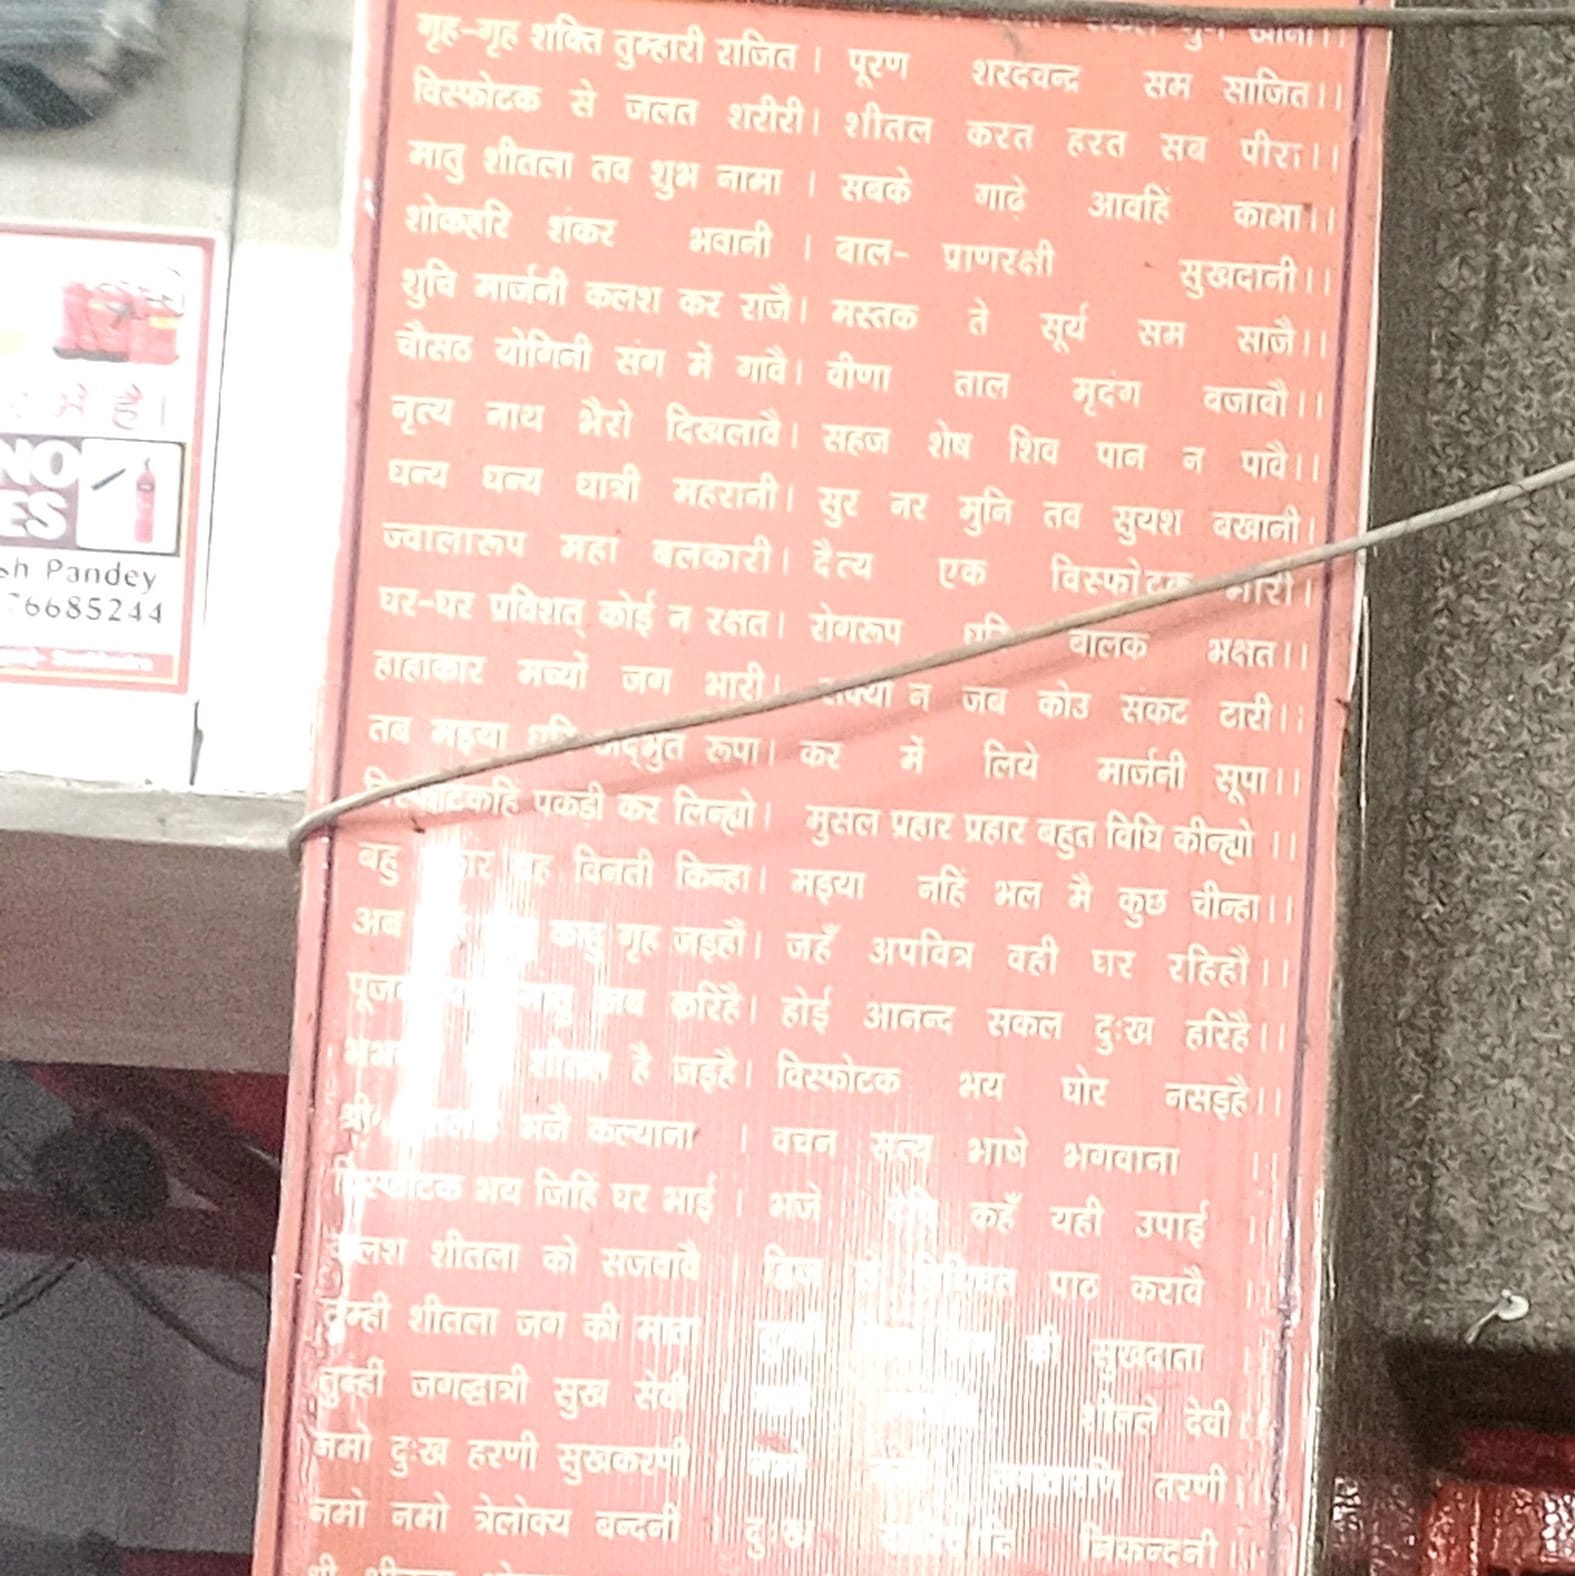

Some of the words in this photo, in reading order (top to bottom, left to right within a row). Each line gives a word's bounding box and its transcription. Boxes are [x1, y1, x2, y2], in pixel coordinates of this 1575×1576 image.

[411, 63, 542, 113] विस्फोटक
[568, 76, 598, 118] से
[622, 93, 699, 127] जलत
[843, 99, 935, 145] शीतल
[965, 119, 1035, 151] करत
[1065, 126, 1129, 158] हरत
[1158, 131, 1209, 163] सब
[820, 423, 891, 457] सहज
[926, 417, 973, 460] शेष
[1008, 422, 1060, 465] शिव
[1094, 440, 1148, 471] पान
[46, 558, 157, 595] Pandey
